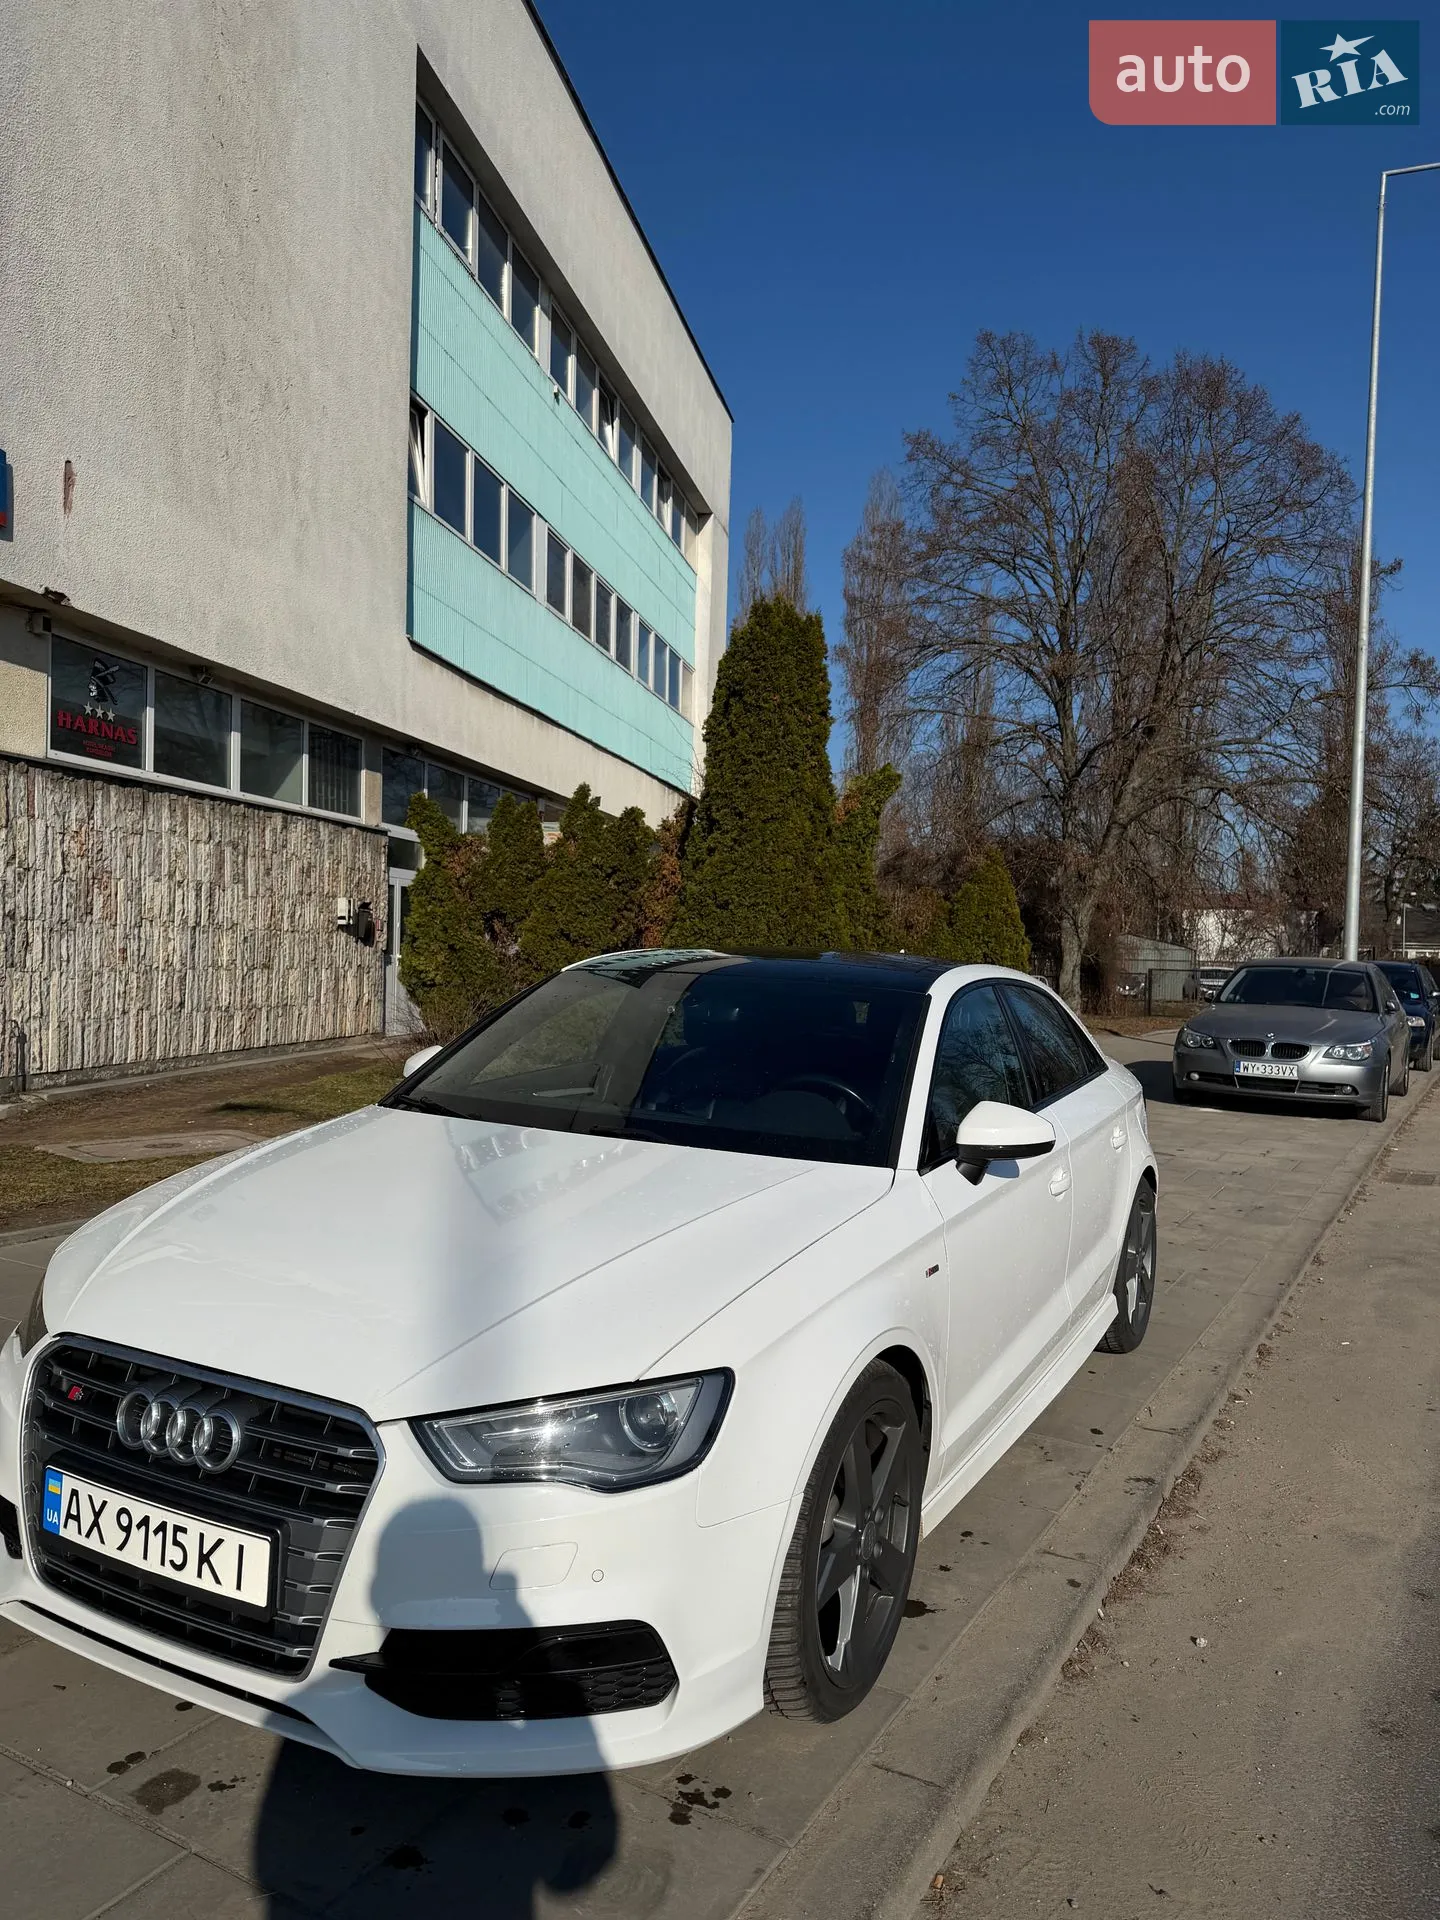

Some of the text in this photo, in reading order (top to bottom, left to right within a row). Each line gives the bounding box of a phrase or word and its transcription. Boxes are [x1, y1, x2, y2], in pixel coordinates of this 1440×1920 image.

[1242, 1062, 1257, 1073] WY
[1260, 1064, 1295, 1077] 333VX
[46, 1508, 59, 1526] UA
[63, 1487, 245, 1592] AX 9115 KI
